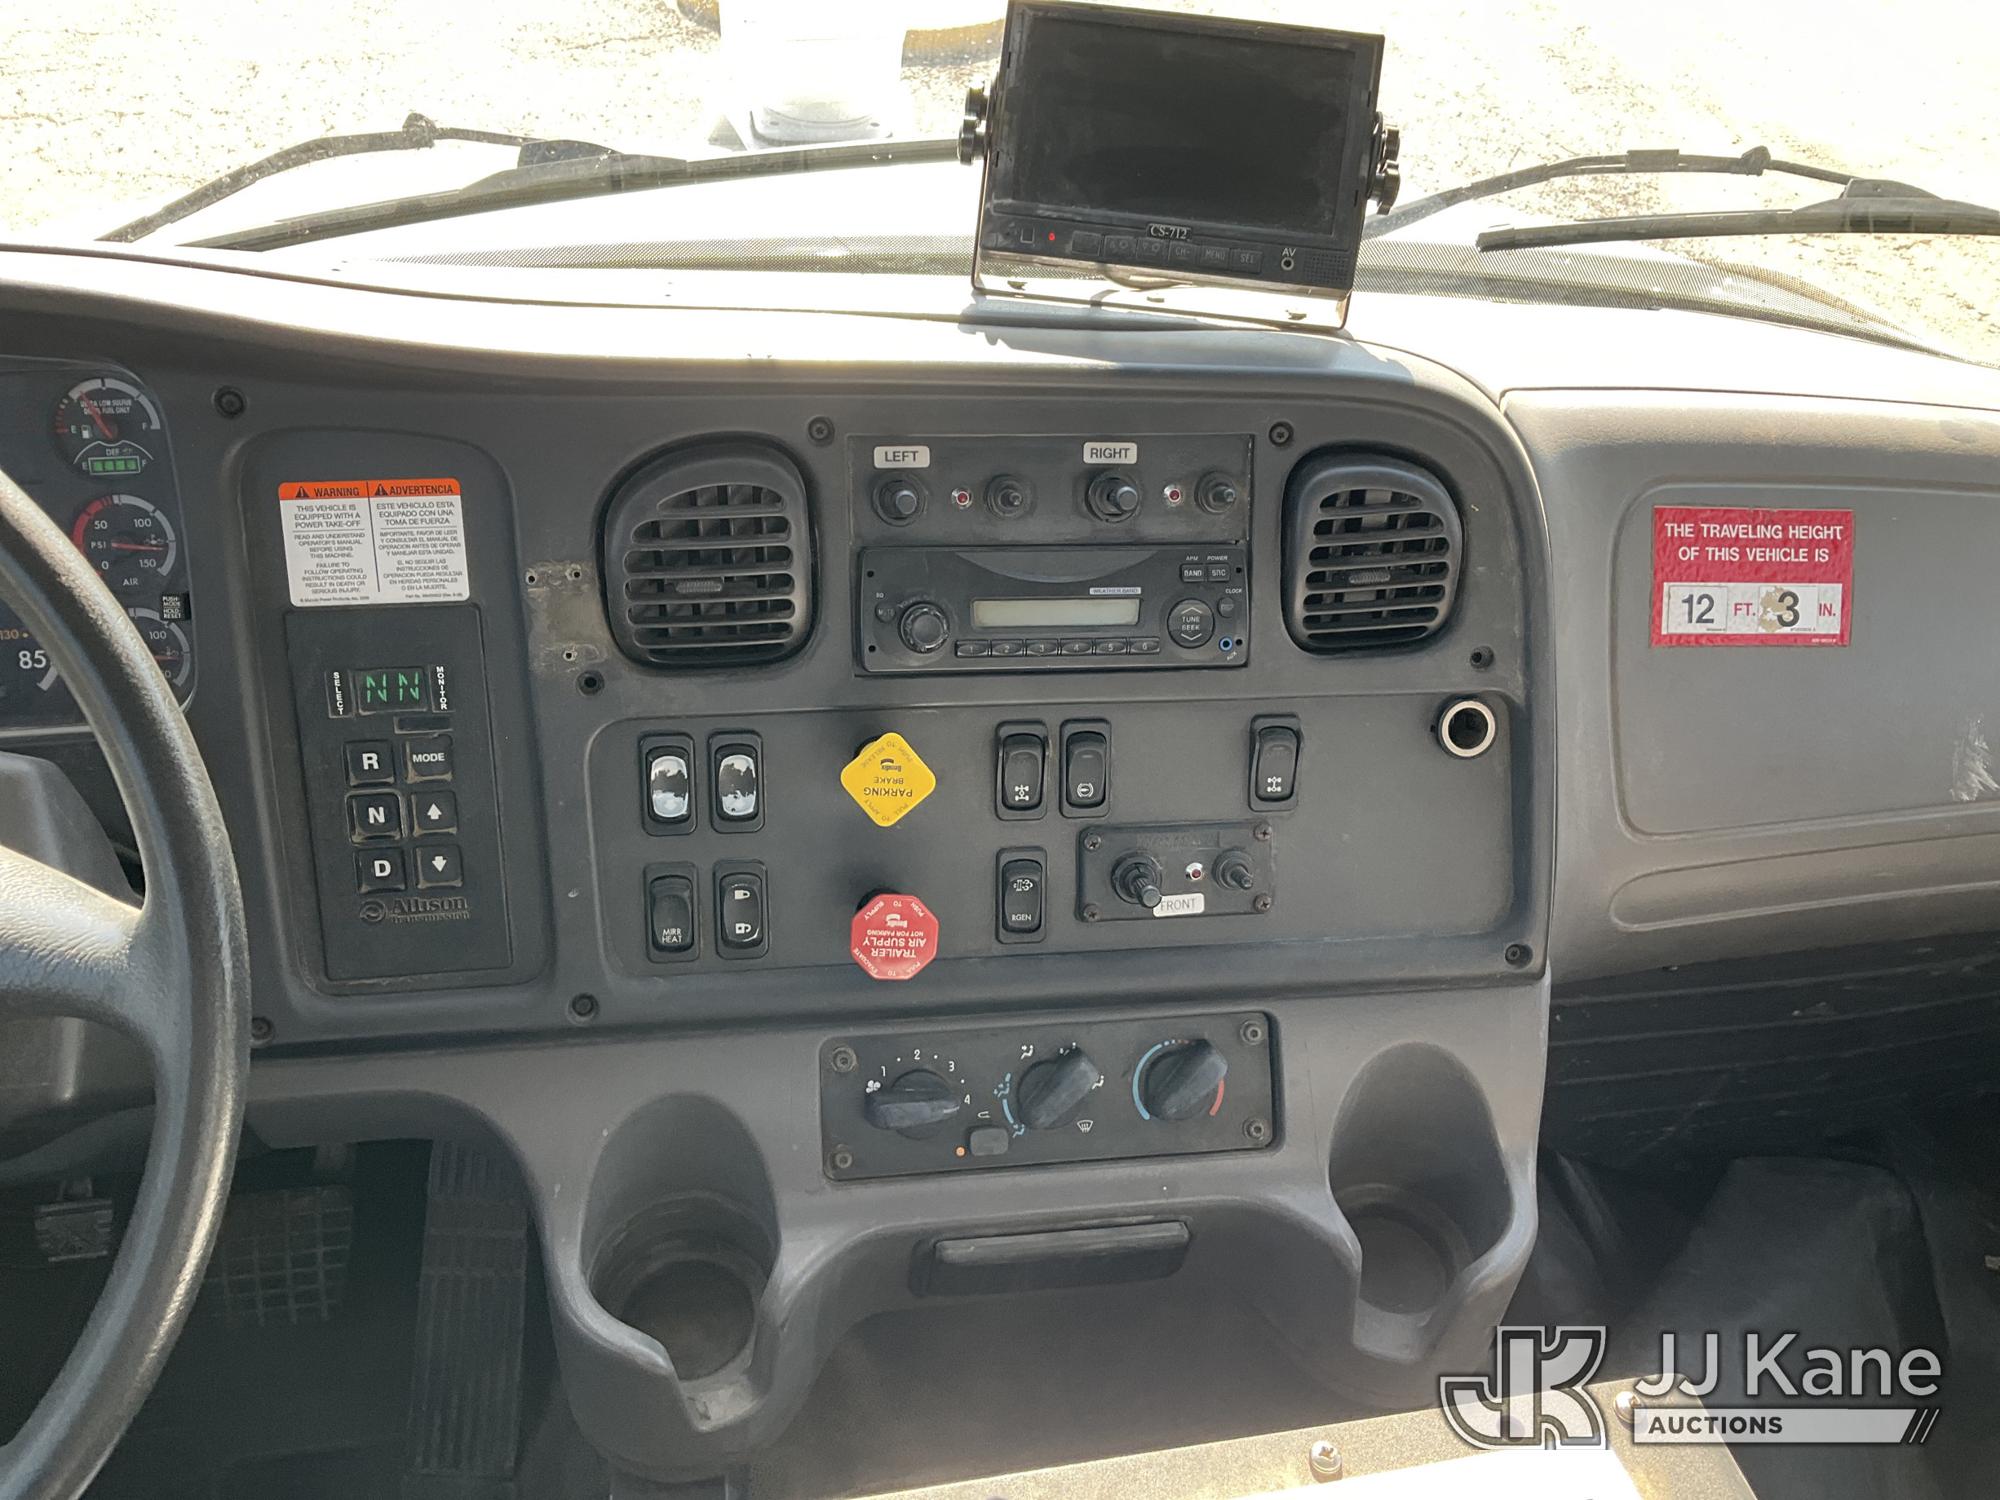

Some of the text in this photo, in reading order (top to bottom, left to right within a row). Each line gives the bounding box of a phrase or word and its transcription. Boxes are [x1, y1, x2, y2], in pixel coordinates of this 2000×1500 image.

[1150, 224, 1188, 240] CS-712
[1282, 248, 1296, 257] AV
[106, 448, 120, 456] DEF
[884, 450, 919, 463] LEFT
[1090, 447, 1131, 461] RIGHT
[314, 487, 360, 497] WARNING
[390, 485, 454, 495] ADVERTENCIA
[315, 504, 347, 512] VEHICLE
[376, 502, 395, 510] ESTE
[294, 512, 332, 521] EQUIPPED
[334, 512, 354, 520] WITH
[379, 510, 417, 518] EQUIPADO
[94, 520, 108, 530] 50
[133, 518, 152, 528] 100
[295, 520, 361, 529] POWER TAKE-OFF
[421, 517, 450, 525] FUERZA
[1665, 523, 1843, 541] THE TRAVELING HEIGHT
[91, 541, 107, 549] PSI
[1678, 546, 1830, 563] OF THIS VEHICLE IS
[101, 561, 110, 570] 0
[139, 559, 156, 568] 150
[1184, 569, 1202, 577] BAND
[123, 577, 139, 586] AIR
[1681, 590, 1837, 628] 12 FT. 3 IN.
[149, 631, 167, 640] 100
[18, 650, 47, 669] 85
[333, 671, 344, 715] SELECT
[436, 666, 448, 710] MONITOR
[362, 752, 380, 770] R
[412, 752, 445, 763] MODE
[874, 776, 904, 785] BRAKE
[863, 786, 913, 798] PARKING
[368, 806, 386, 824] N
[374, 859, 392, 877] D
[1159, 898, 1197, 912] FRONT
[1011, 913, 1032, 922] RGEN
[662, 927, 682, 936] MIRR
[661, 935, 682, 944] HEAT
[862, 936, 927, 948] AIR SUPPLY
[871, 947, 917, 958] TRAILER
[887, 969, 896, 977] TO
[914, 1049, 921, 1060] 2
[948, 1060, 955, 1072] 3
[881, 1066, 887, 1077] 1
[963, 1094, 971, 1105] 4
